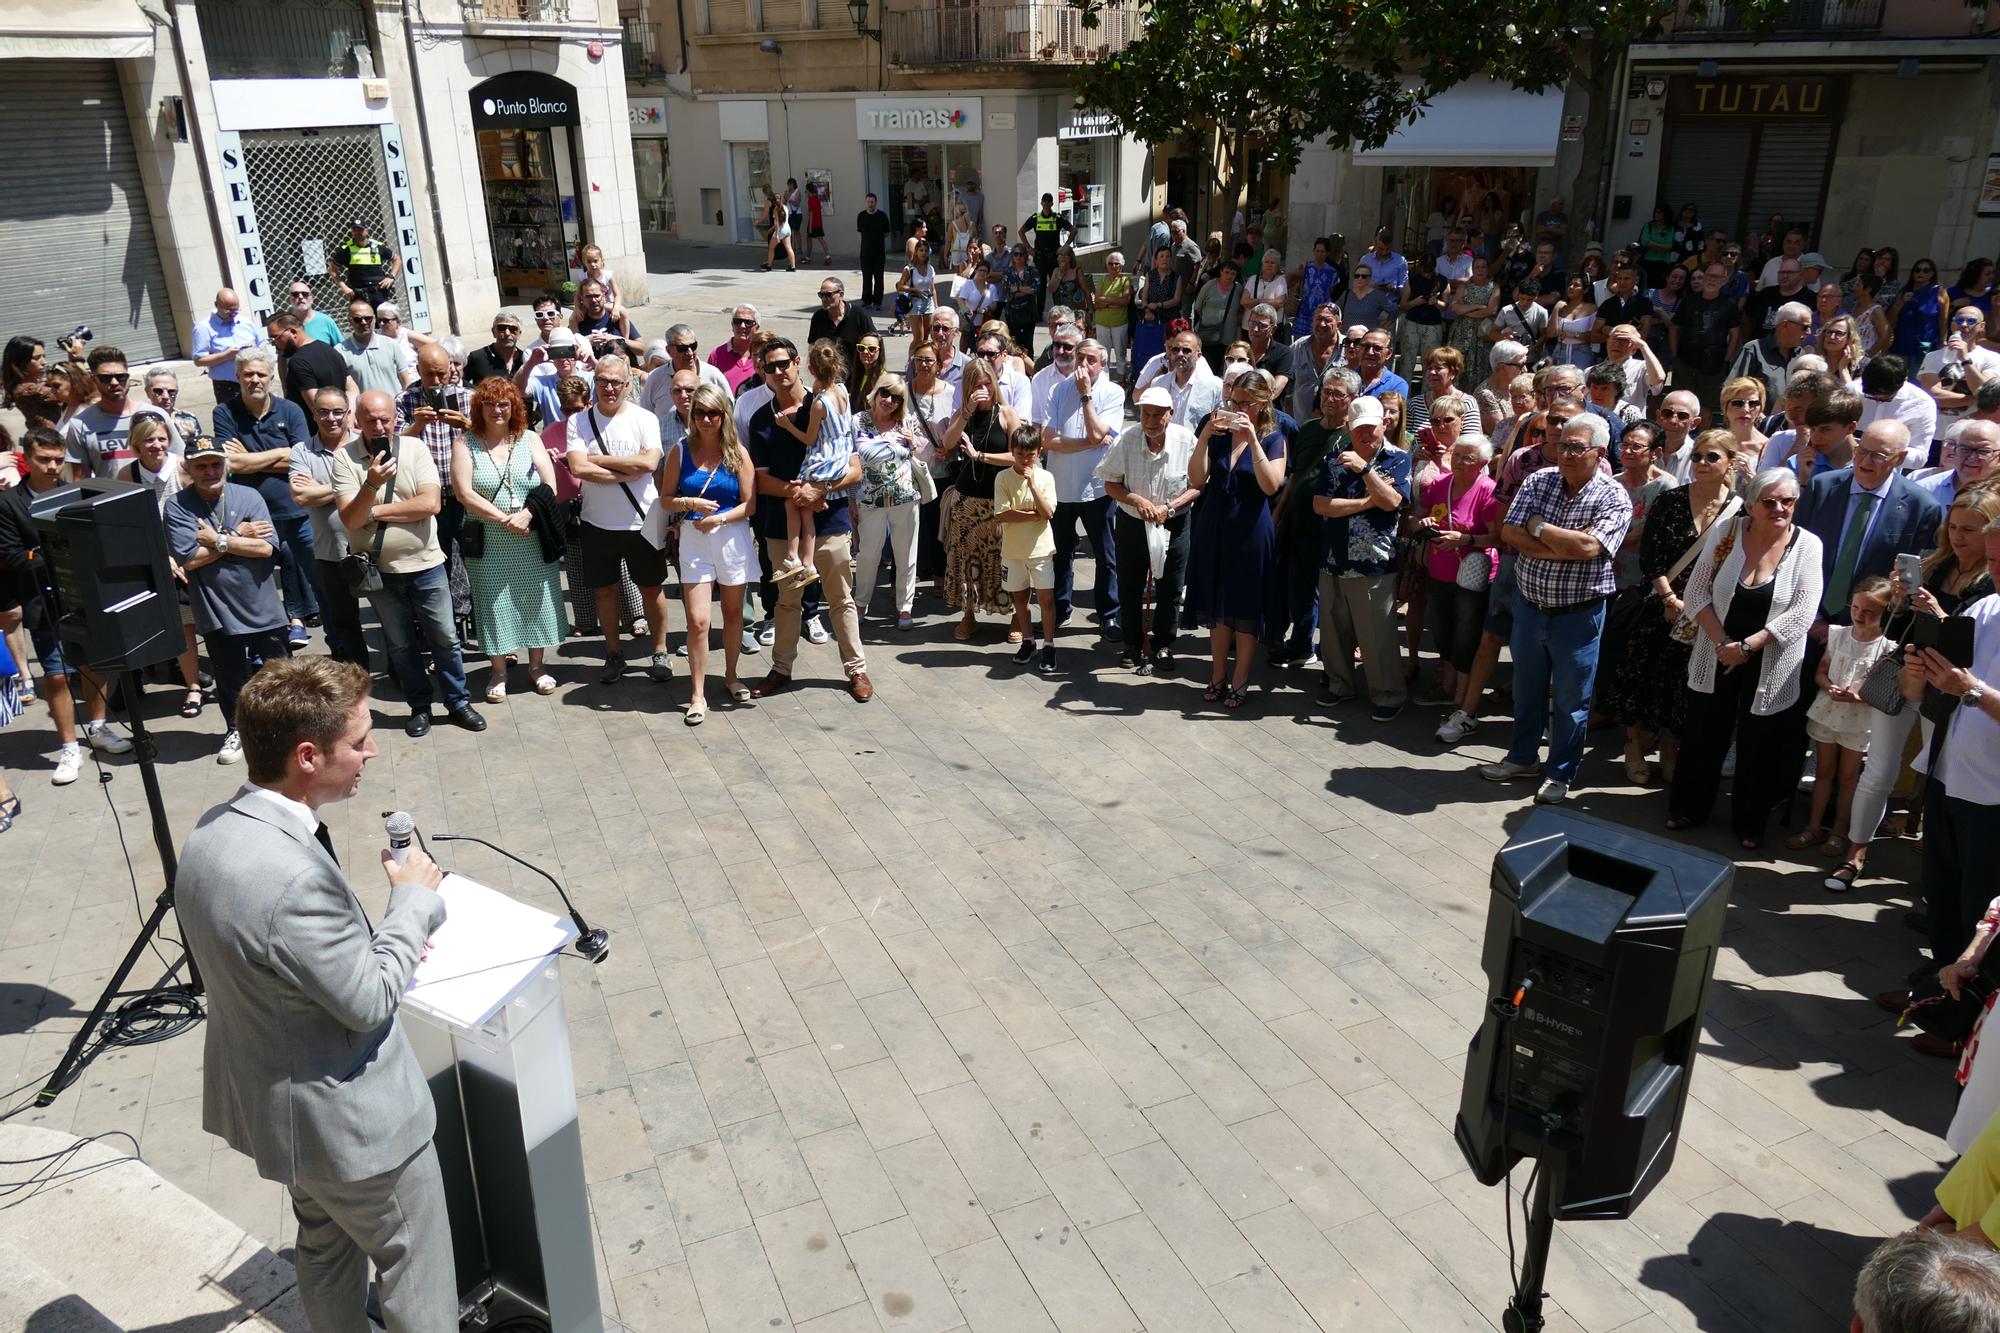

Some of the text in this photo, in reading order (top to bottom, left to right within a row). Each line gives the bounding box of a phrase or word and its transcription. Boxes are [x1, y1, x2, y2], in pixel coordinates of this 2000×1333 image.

[497, 97, 568, 116] Punto Blanco
[1695, 84, 1823, 112] TUTAU
[387, 140, 424, 302] SELECT
[222, 148, 272, 328] SELECT
[98, 438, 129, 452] Lev
